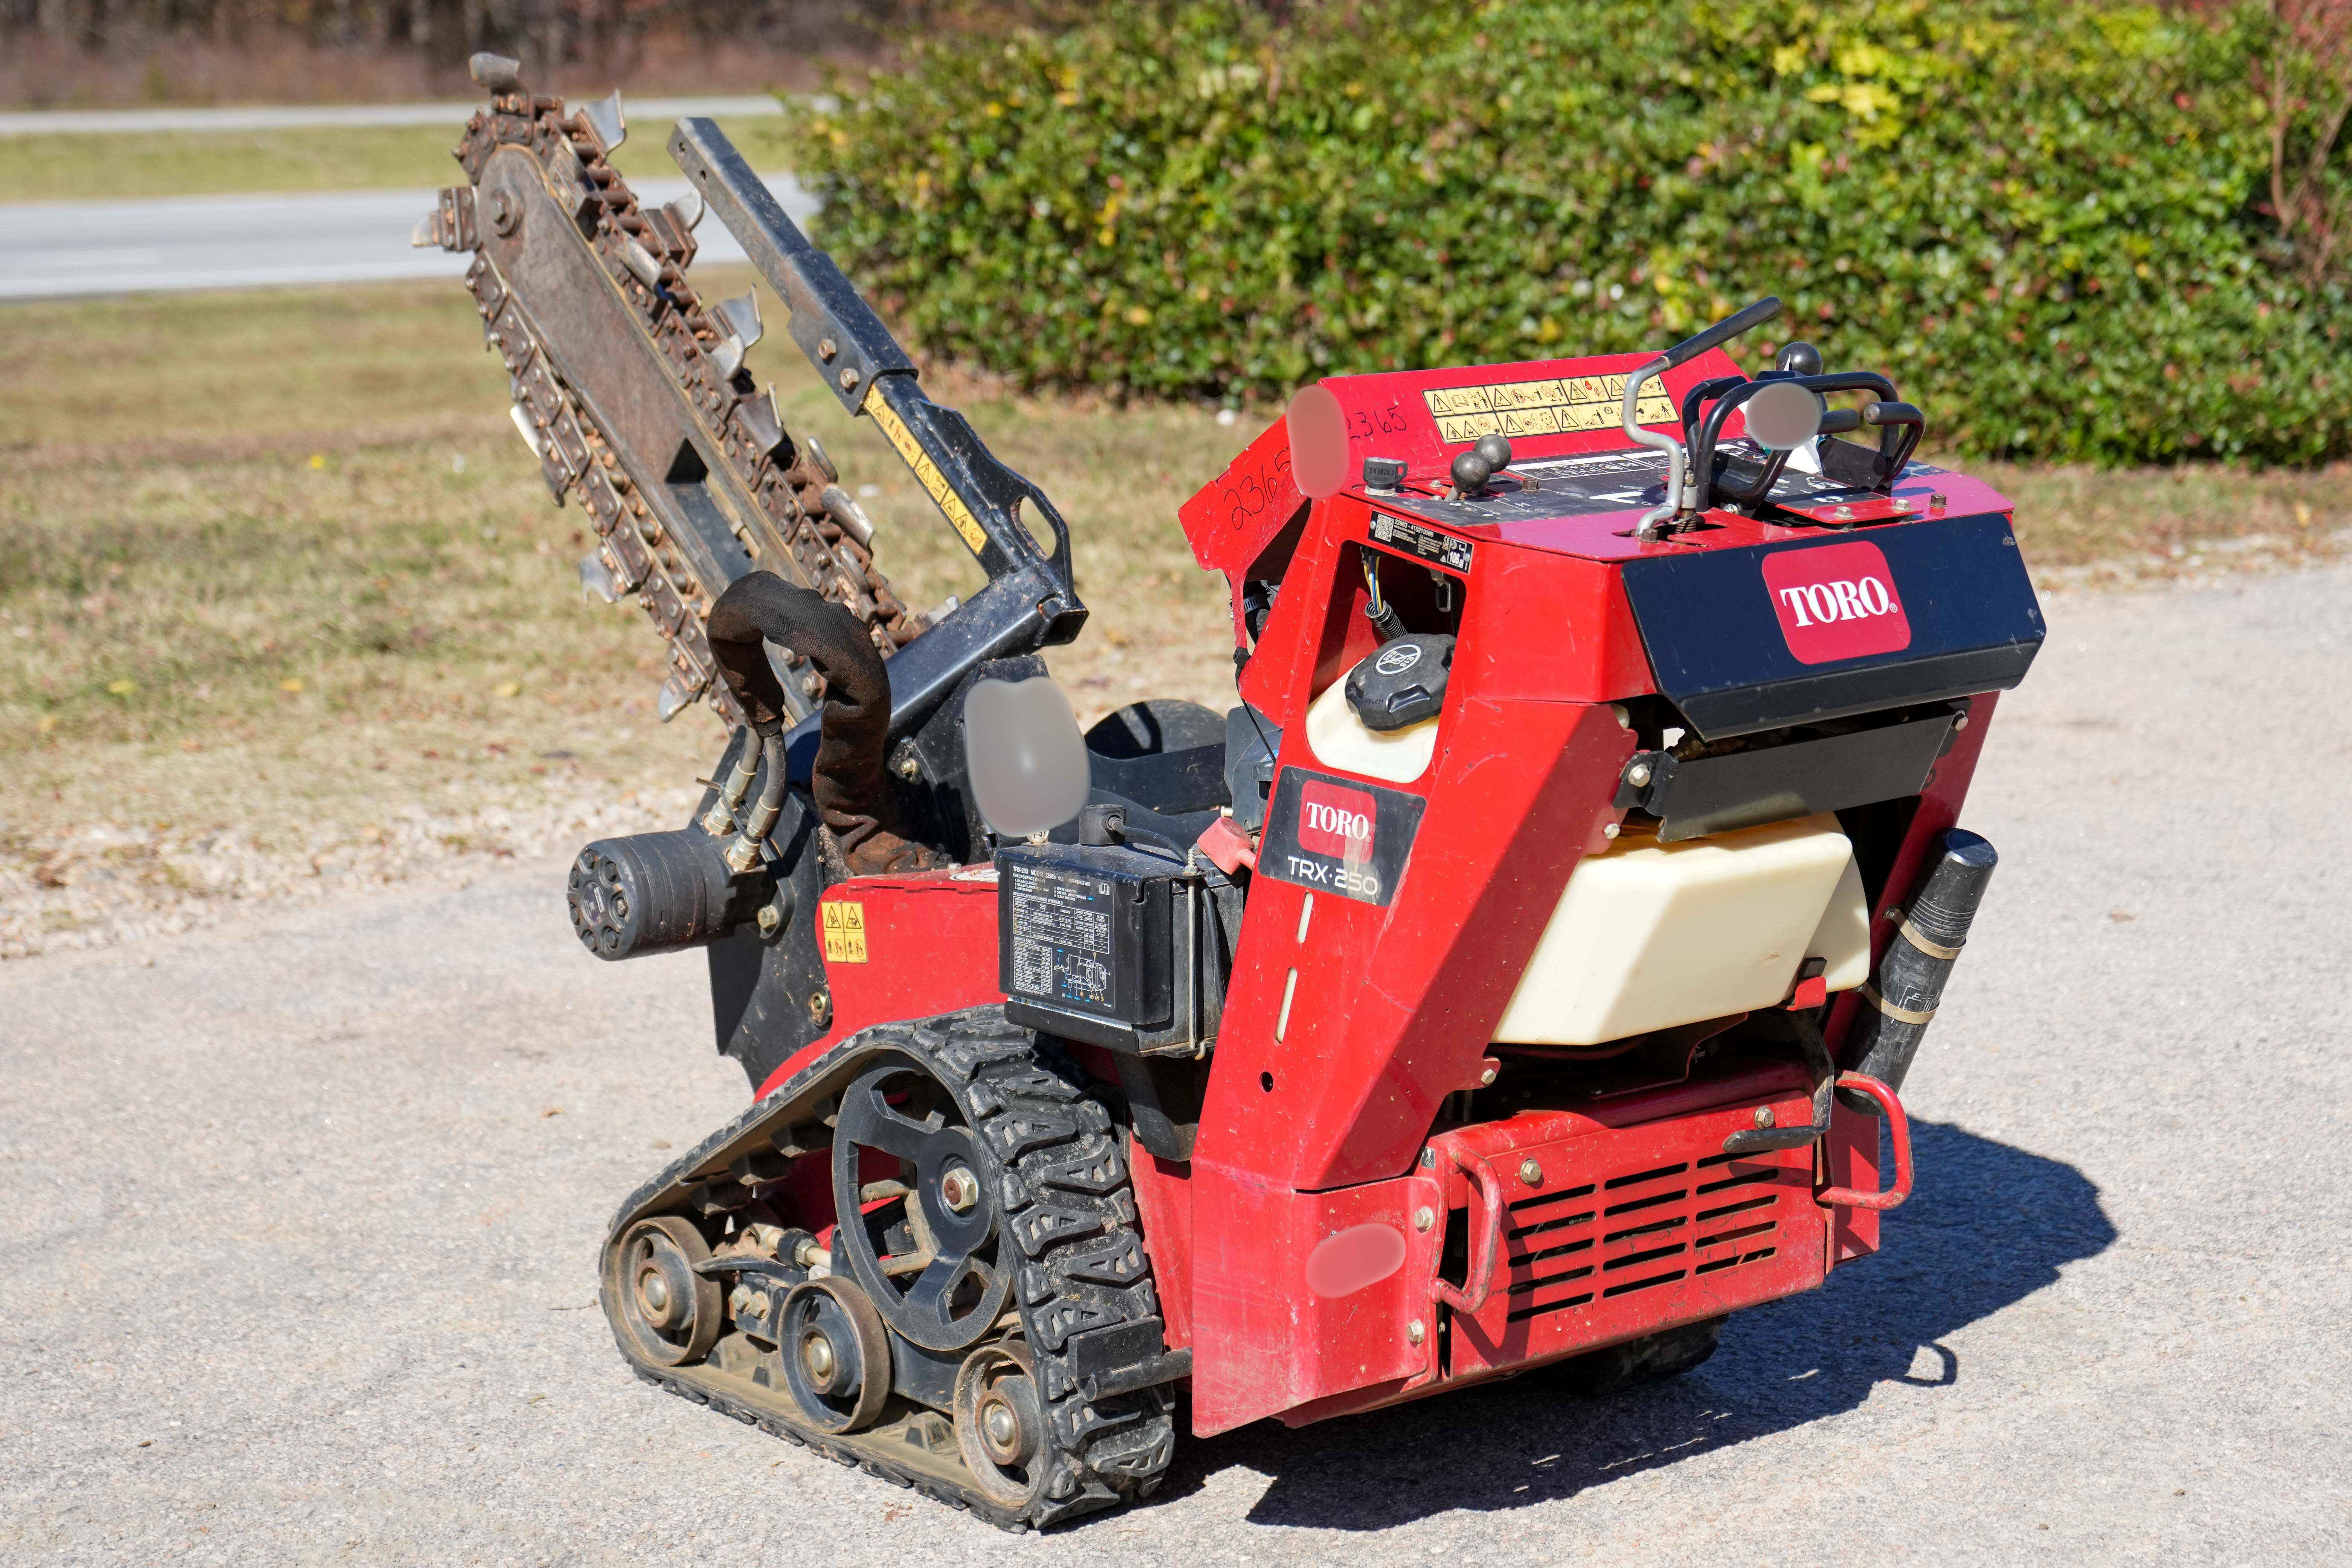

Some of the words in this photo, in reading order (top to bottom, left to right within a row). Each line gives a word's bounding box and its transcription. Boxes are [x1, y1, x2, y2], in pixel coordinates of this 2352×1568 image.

[1368, 467, 1393, 477] TORO
[1394, 519, 1408, 528] 22983
[1449, 551, 1461, 565] 106
[1779, 577, 1889, 627] TORO
[1383, 651, 1398, 661] E85
[1400, 657, 1415, 667] E15
[1306, 802, 1369, 840] TORO
